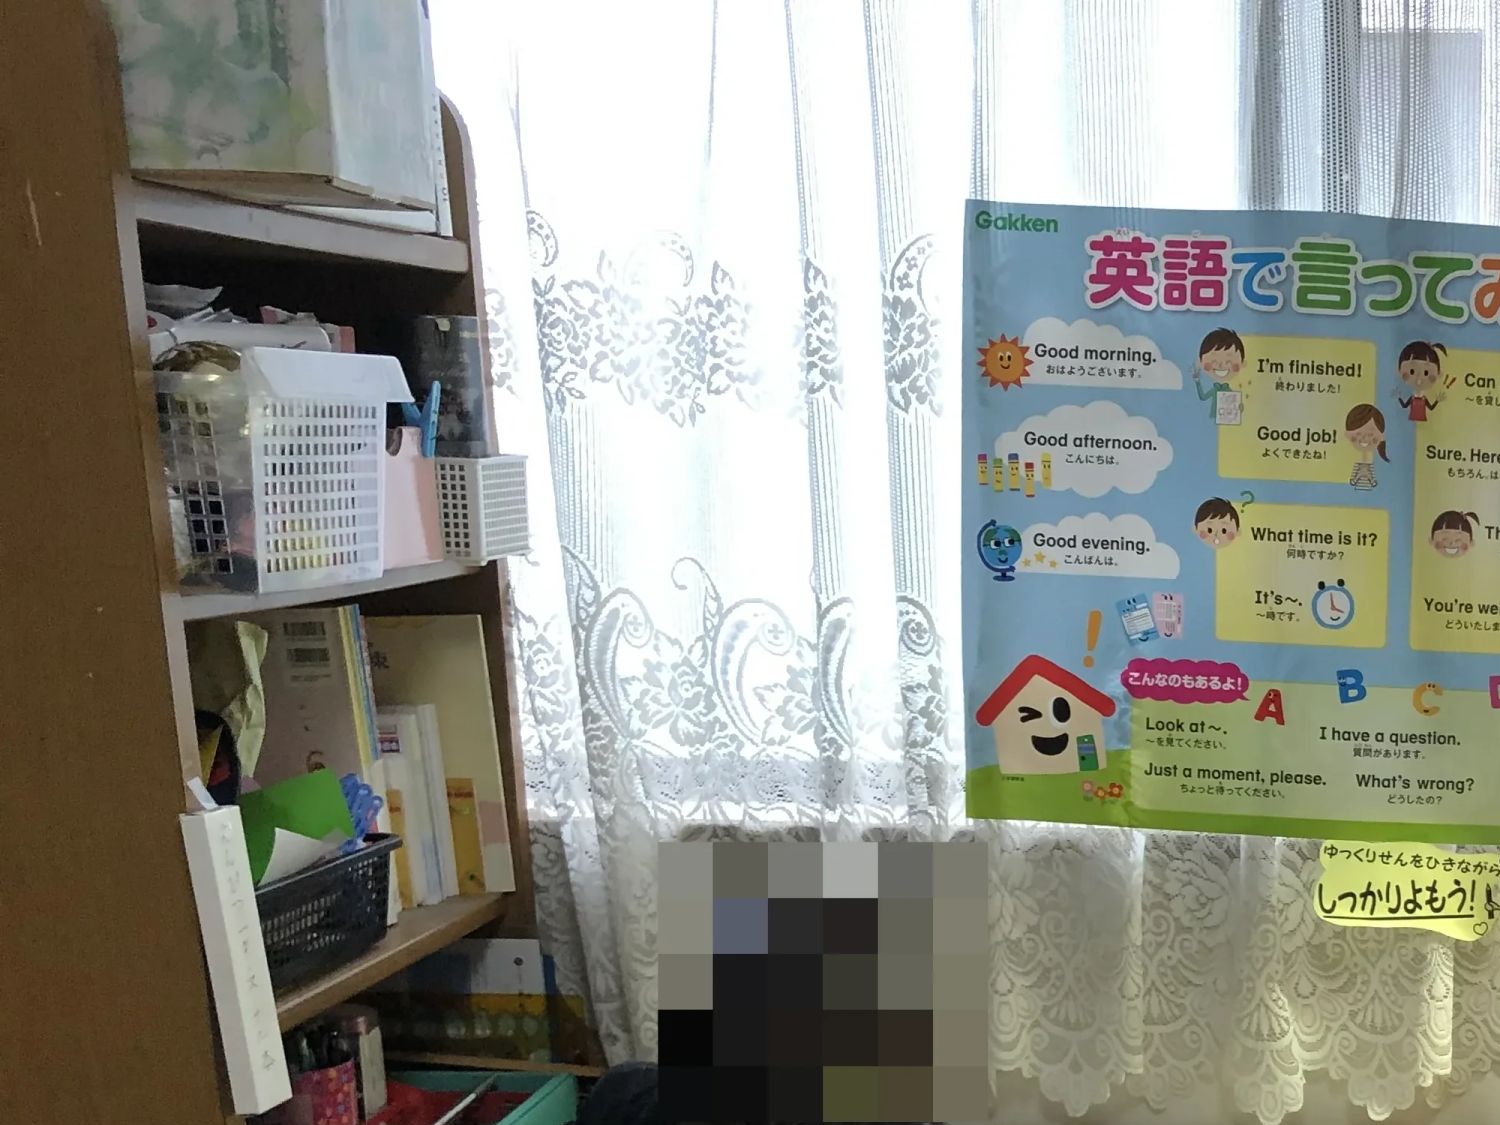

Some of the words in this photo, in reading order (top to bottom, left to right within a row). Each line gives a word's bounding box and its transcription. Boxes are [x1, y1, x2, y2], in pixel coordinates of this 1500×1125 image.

[975, 210, 1058, 232] Gakken
[1035, 344, 1078, 359] Good
[1085, 347, 1156, 365] morning.
[1046, 365, 1141, 378] おはようございます。
[1258, 358, 1283, 373] I'm
[1289, 360, 1361, 377] finished!
[1276, 381, 1340, 393] 終わりました!
[1465, 373, 1495, 388] Can
[1024, 432, 1067, 446] Good
[1073, 435, 1156, 450] afternoon.
[1258, 426, 1300, 441] Good
[1306, 428, 1336, 445] job!
[1066, 454, 1119, 465] こんにちは。
[1262, 448, 1326, 459] よくできたね!
[1426, 445, 1466, 461] Sure.
[1034, 533, 1076, 548] Good
[1082, 537, 1149, 555] evening.
[1251, 527, 1293, 542] What
[1298, 529, 1333, 544] time
[1339, 531, 1351, 545] is
[1358, 532, 1377, 546] it?
[1064, 555, 1117, 566] こんばんは。
[1287, 549, 1344, 560] 何時ですか?
[1424, 598, 1473, 613] You're
[1129, 672, 1243, 691] こんなのもあるよ!
[1254, 689, 1284, 725] A
[1337, 669, 1367, 704] B
[1412, 682, 1443, 716] C
[1146, 717, 1184, 732] Look
[1320, 727, 1327, 739] I
[1332, 727, 1370, 742] have
[1375, 732, 1384, 742] a
[1390, 731, 1460, 746] question.
[1353, 748, 1424, 759] 質問があります。
[1144, 763, 1177, 777] Just
[1183, 768, 1192, 778] a
[1198, 769, 1264, 784] moment,
[1270, 771, 1326, 785] please.
[1356, 774, 1410, 789] What's
[1417, 778, 1474, 794] wrong?
[1388, 794, 1442, 804] どうしたの?
[1324, 845, 1500, 877] ゆっくりせんをひきながら
[1319, 880, 1475, 914] しっかりよもう!
